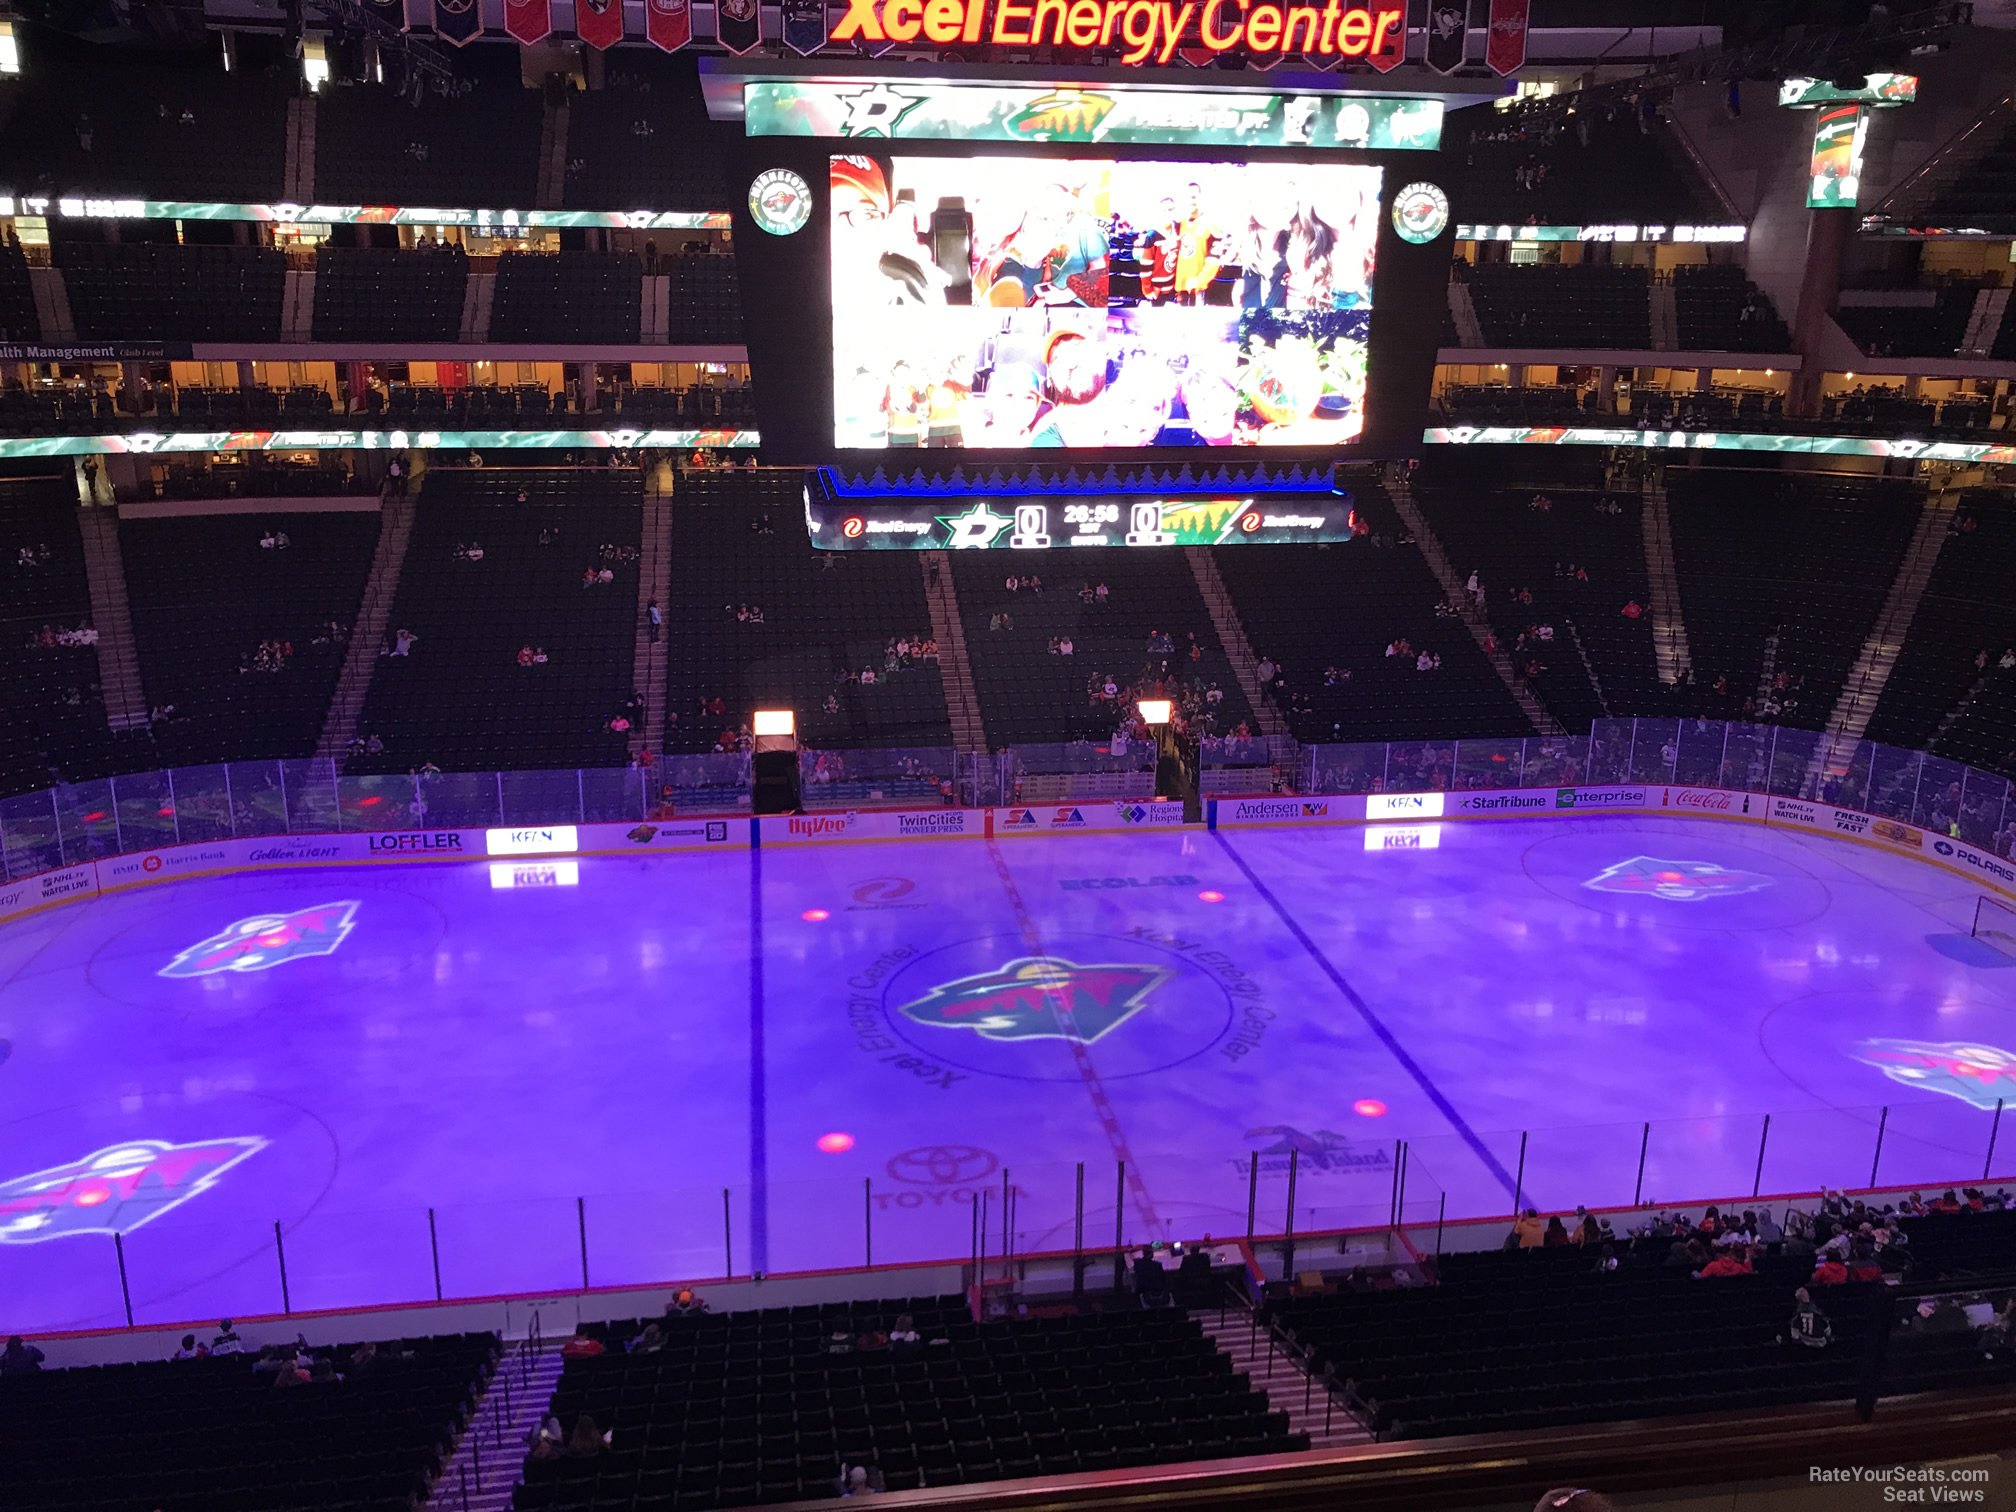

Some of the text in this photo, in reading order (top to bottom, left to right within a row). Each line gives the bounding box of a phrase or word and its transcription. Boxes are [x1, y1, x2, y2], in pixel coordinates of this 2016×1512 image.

[830, 0, 1400, 64] Xcel Energy Center
[27, 346, 115, 360] Management
[1472, 796, 1546, 809] StarTribune
[1561, 789, 1644, 804] enterprise
[1236, 802, 1299, 815] Andersen
[1774, 809, 1816, 823] WATCH LIVE
[897, 813, 964, 827] TwinCities
[1834, 811, 1869, 824] FRESH
[899, 824, 964, 835] PIONEER PRESS
[1836, 822, 1864, 833] FAST
[369, 833, 462, 850] LOFFLER
[166, 854, 198, 866] Harris
[200, 851, 226, 861] Bank
[298, 847, 340, 858] LIGHT
[1956, 849, 2015, 882] POLARIS
[42, 879, 89, 898] WATCH LIVE
[847, 944, 920, 989] Center
[1194, 952, 1265, 1003] Energy
[848, 993, 895, 1052] Energy
[1220, 1006, 1277, 1063] Center
[872, 1184, 1029, 1210] TOYOTA
